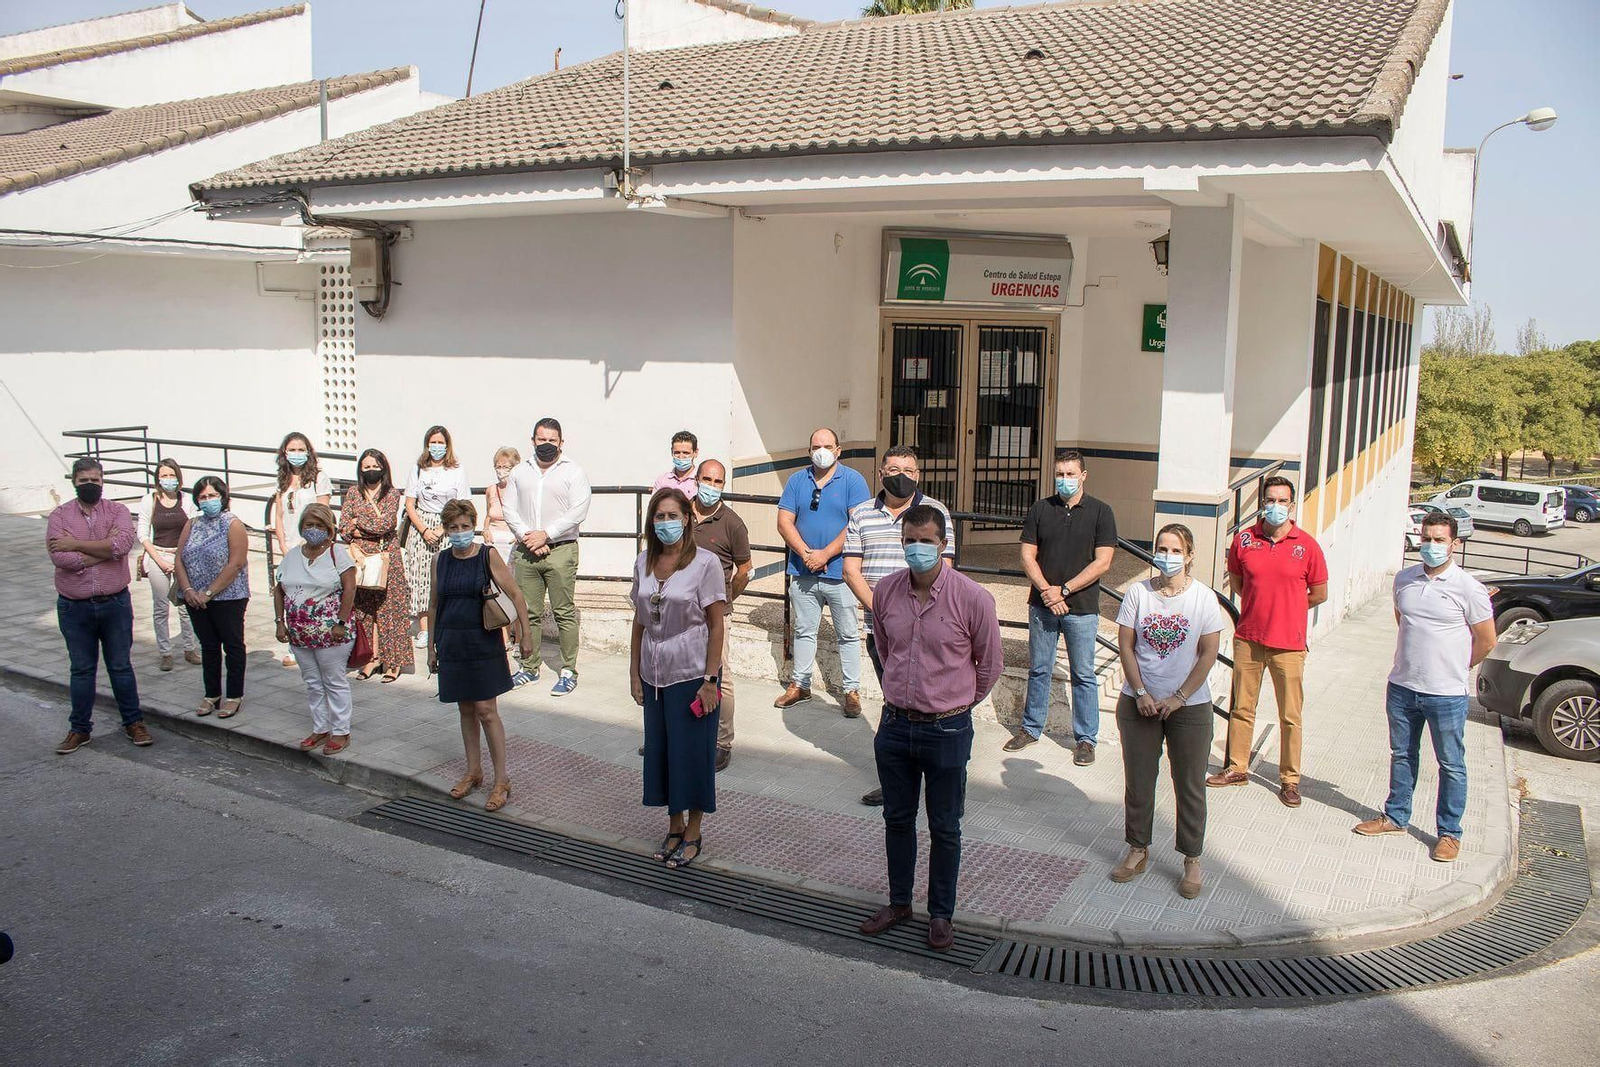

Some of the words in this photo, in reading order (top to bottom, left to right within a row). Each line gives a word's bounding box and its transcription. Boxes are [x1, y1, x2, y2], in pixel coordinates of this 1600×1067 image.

[984, 269, 1007, 279] Centro
[1009, 271, 1017, 280] de
[1019, 271, 1038, 280] Salud
[1039, 272, 1062, 283] Estepa
[991, 282, 1060, 298] URGENCIAS
[1241, 533, 1252, 548] 2
